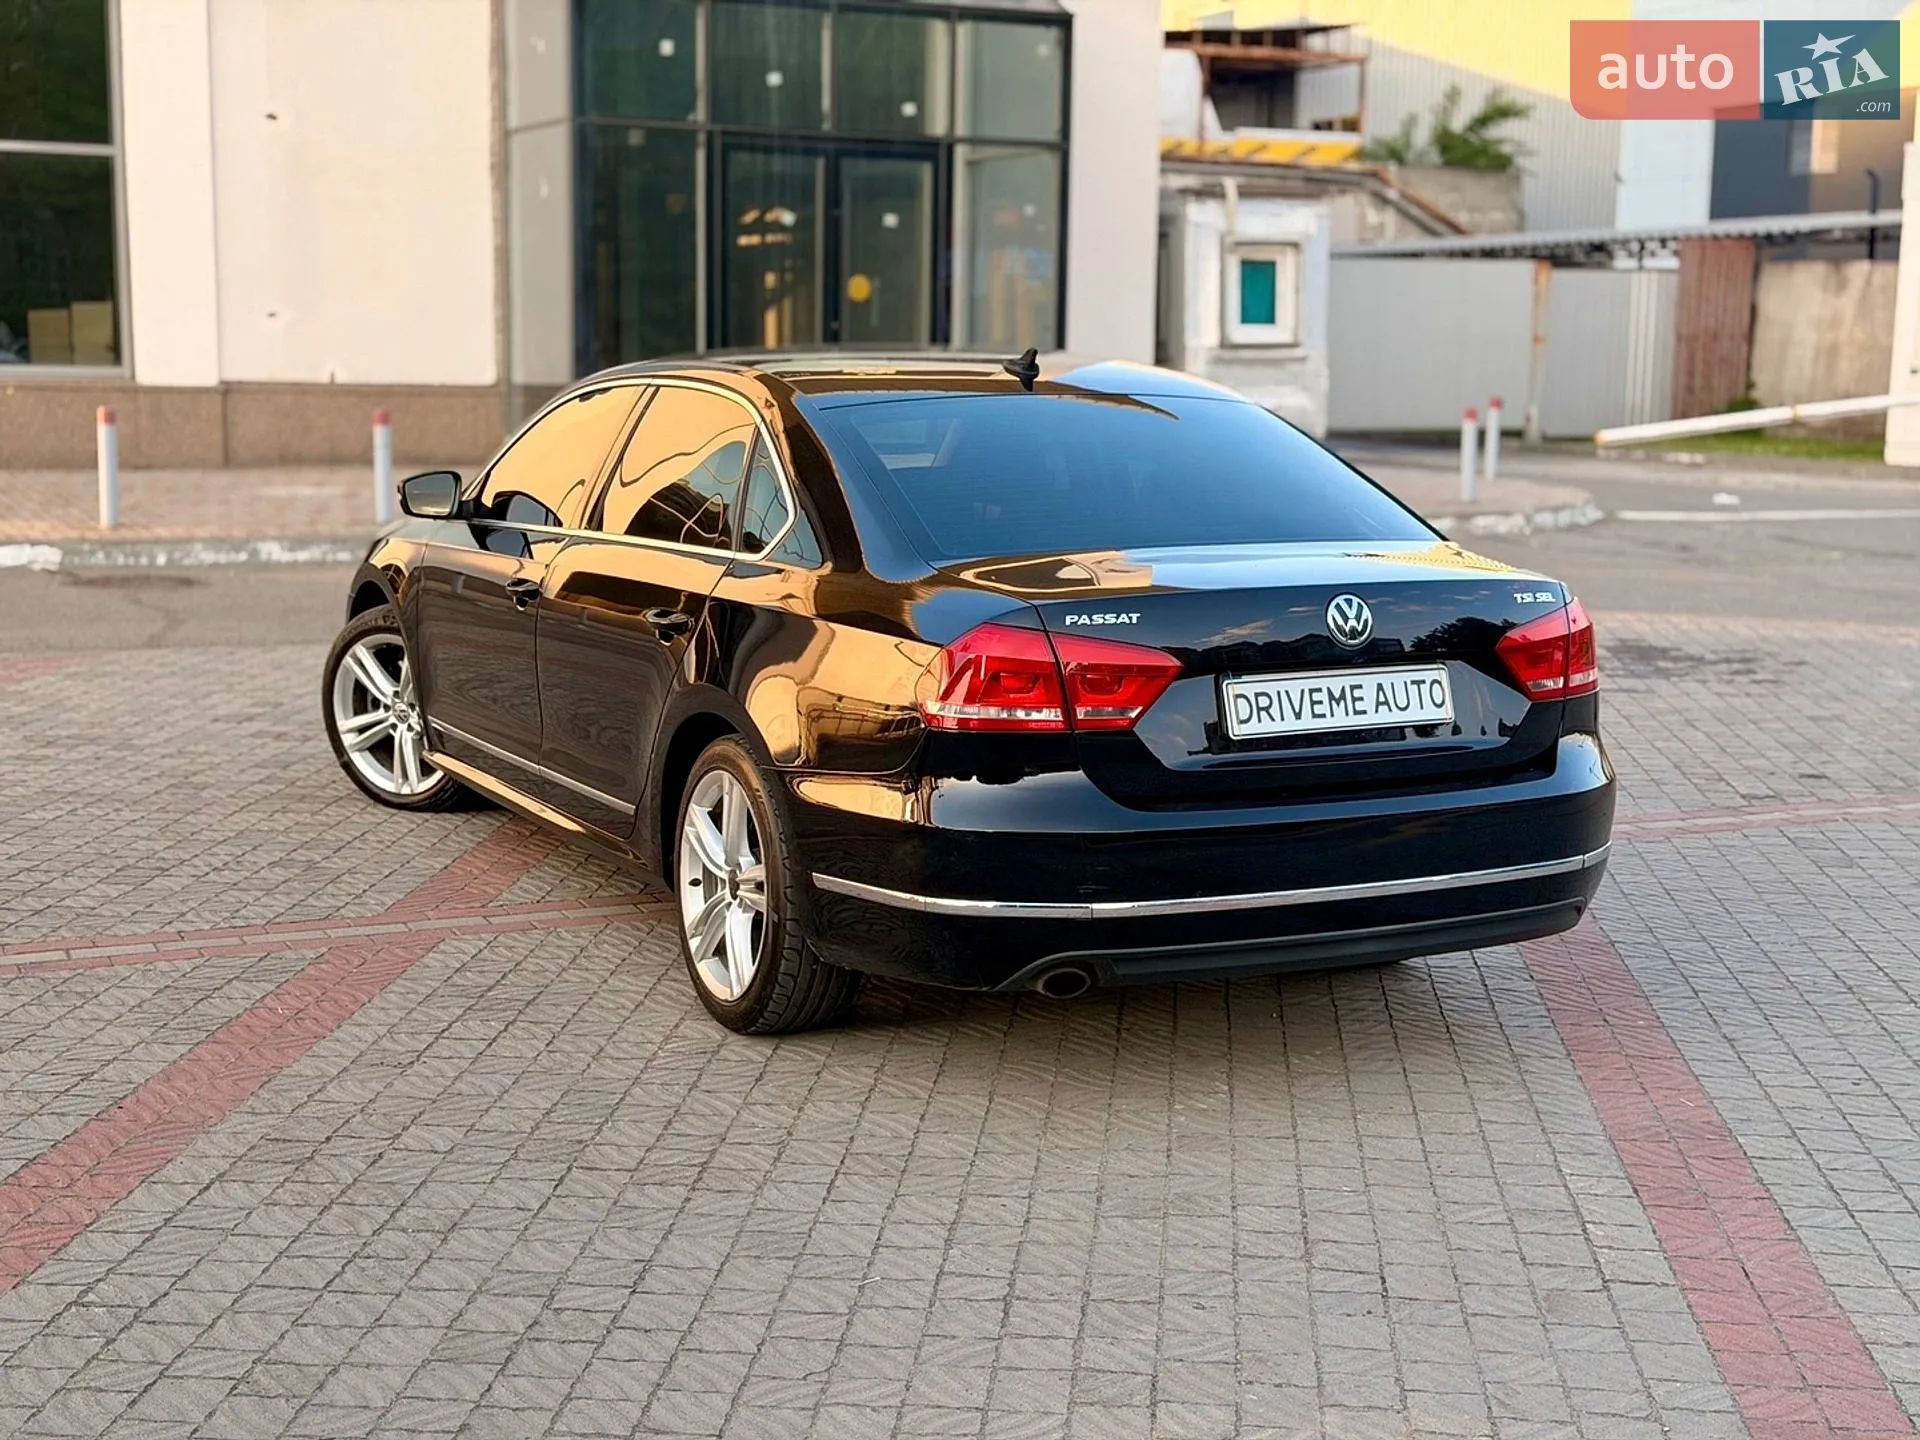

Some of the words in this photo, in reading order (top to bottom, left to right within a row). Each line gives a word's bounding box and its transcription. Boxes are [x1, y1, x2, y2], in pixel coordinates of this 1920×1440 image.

[1065, 613, 1141, 626] PASSAT
[1233, 683, 1368, 725] DRIVEME
[1374, 678, 1447, 714] AUTO
